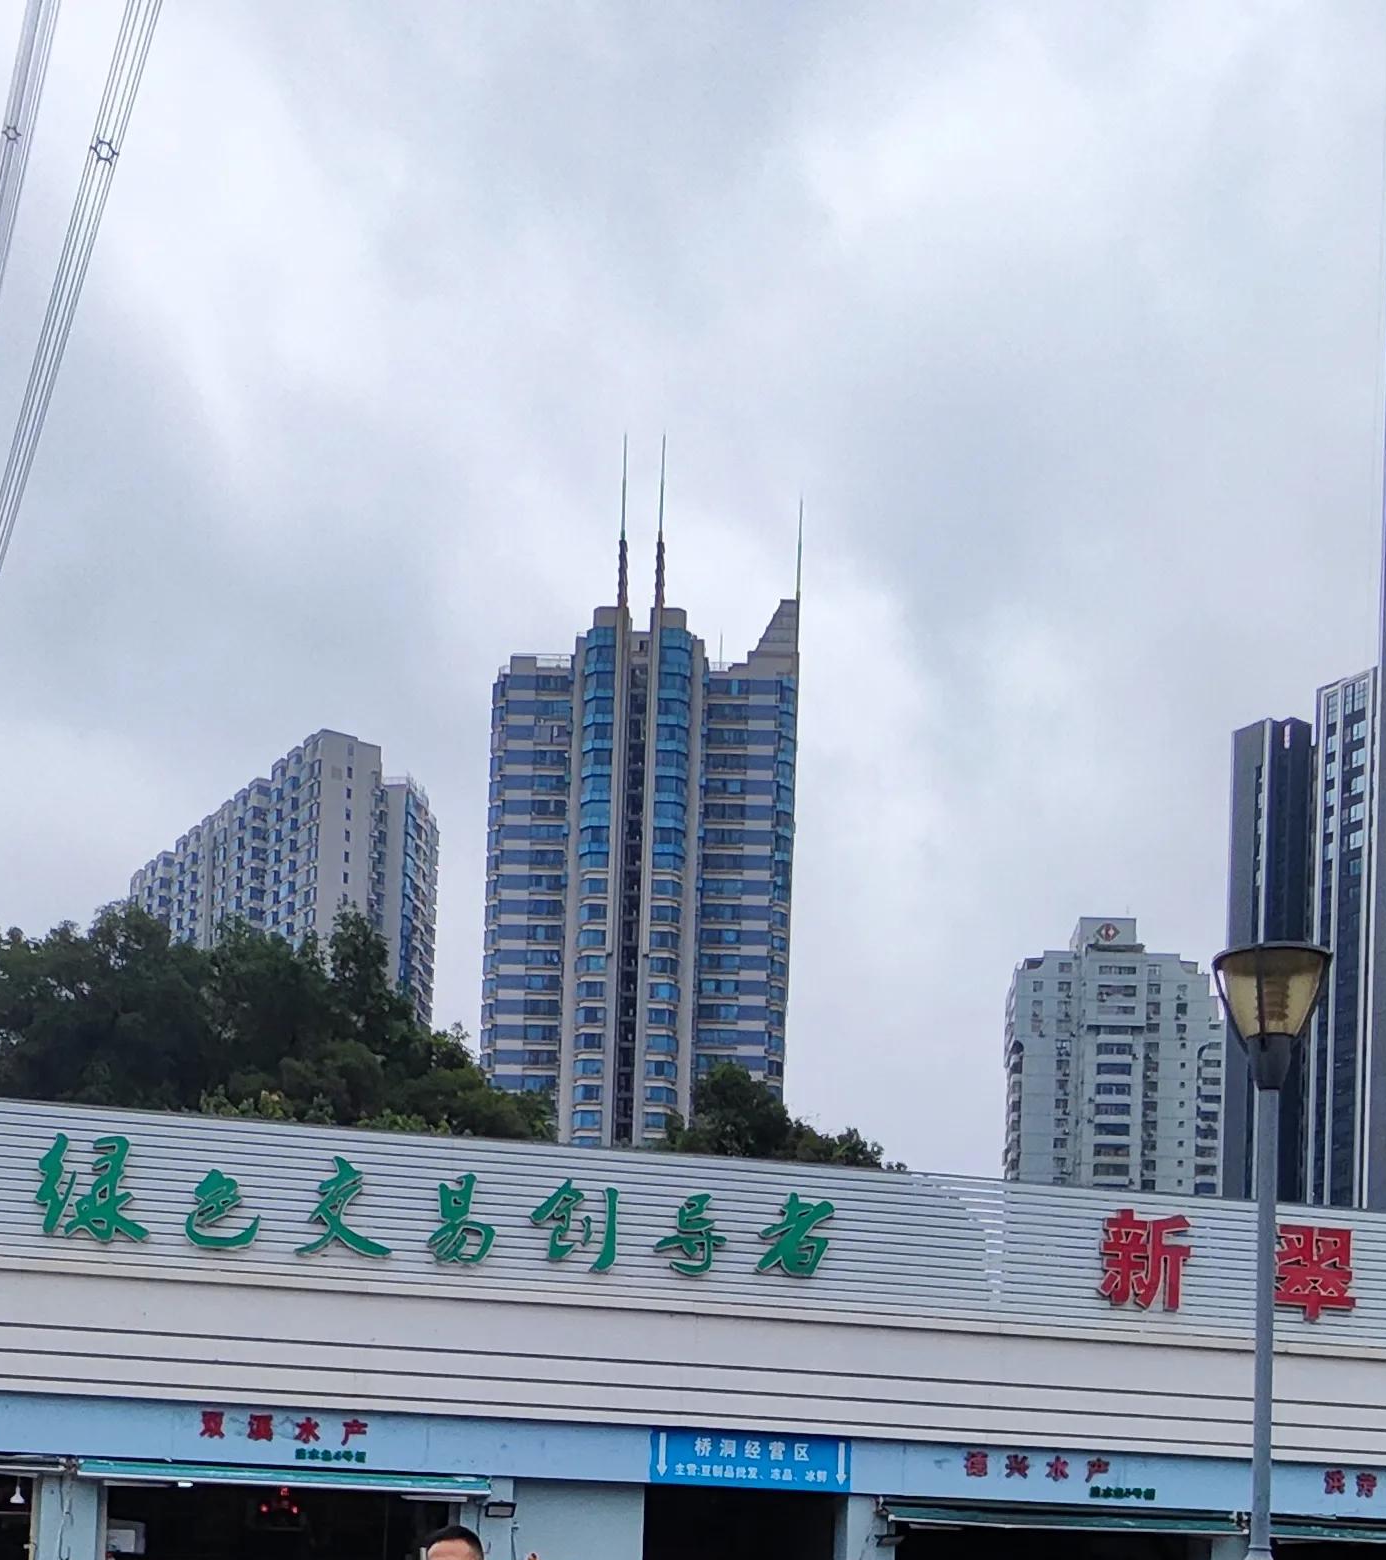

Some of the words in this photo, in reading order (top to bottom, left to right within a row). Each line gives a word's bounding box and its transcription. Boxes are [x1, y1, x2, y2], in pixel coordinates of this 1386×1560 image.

[35, 1132, 835, 1278] 绿色交易创导者
[695, 1437, 810, 1461] 桥洞经营区
